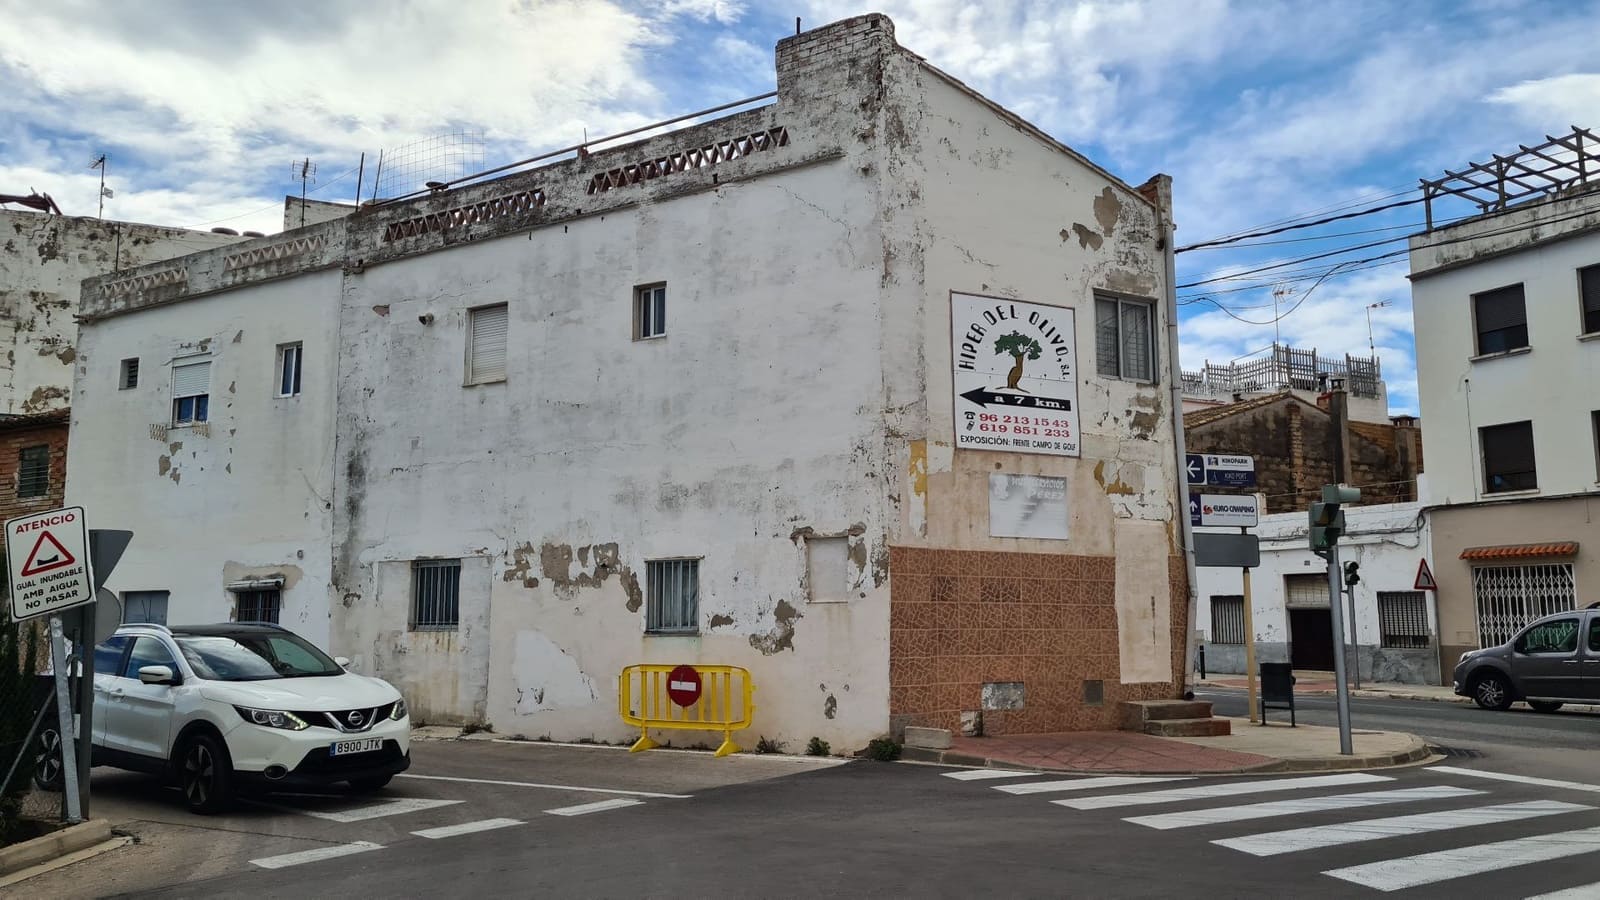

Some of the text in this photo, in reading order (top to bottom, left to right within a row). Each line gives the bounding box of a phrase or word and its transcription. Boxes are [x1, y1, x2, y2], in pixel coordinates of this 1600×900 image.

[959, 323, 987, 370] HIPER
[983, 305, 1018, 325] DEL
[1014, 396, 1024, 404] 7
[1035, 398, 1065, 409] km.
[979, 413, 1069, 428] 96 213 15 43
[980, 423, 1070, 438] 619 851 233
[960, 435, 1010, 446] EXPOSICIÓN:
[1013, 438, 1030, 447] FRENTE
[1032, 440, 1052, 449] CAMPO
[1063, 443, 1076, 451] GOLF
[16, 512, 75, 534] ATENCIÓ
[17, 566, 83, 591] GUAL INUNDABLE
[23, 579, 79, 600] AMB AIGUA
[25, 589, 78, 610] NO PASAR
[337, 740, 381, 753] 8900 JTK
